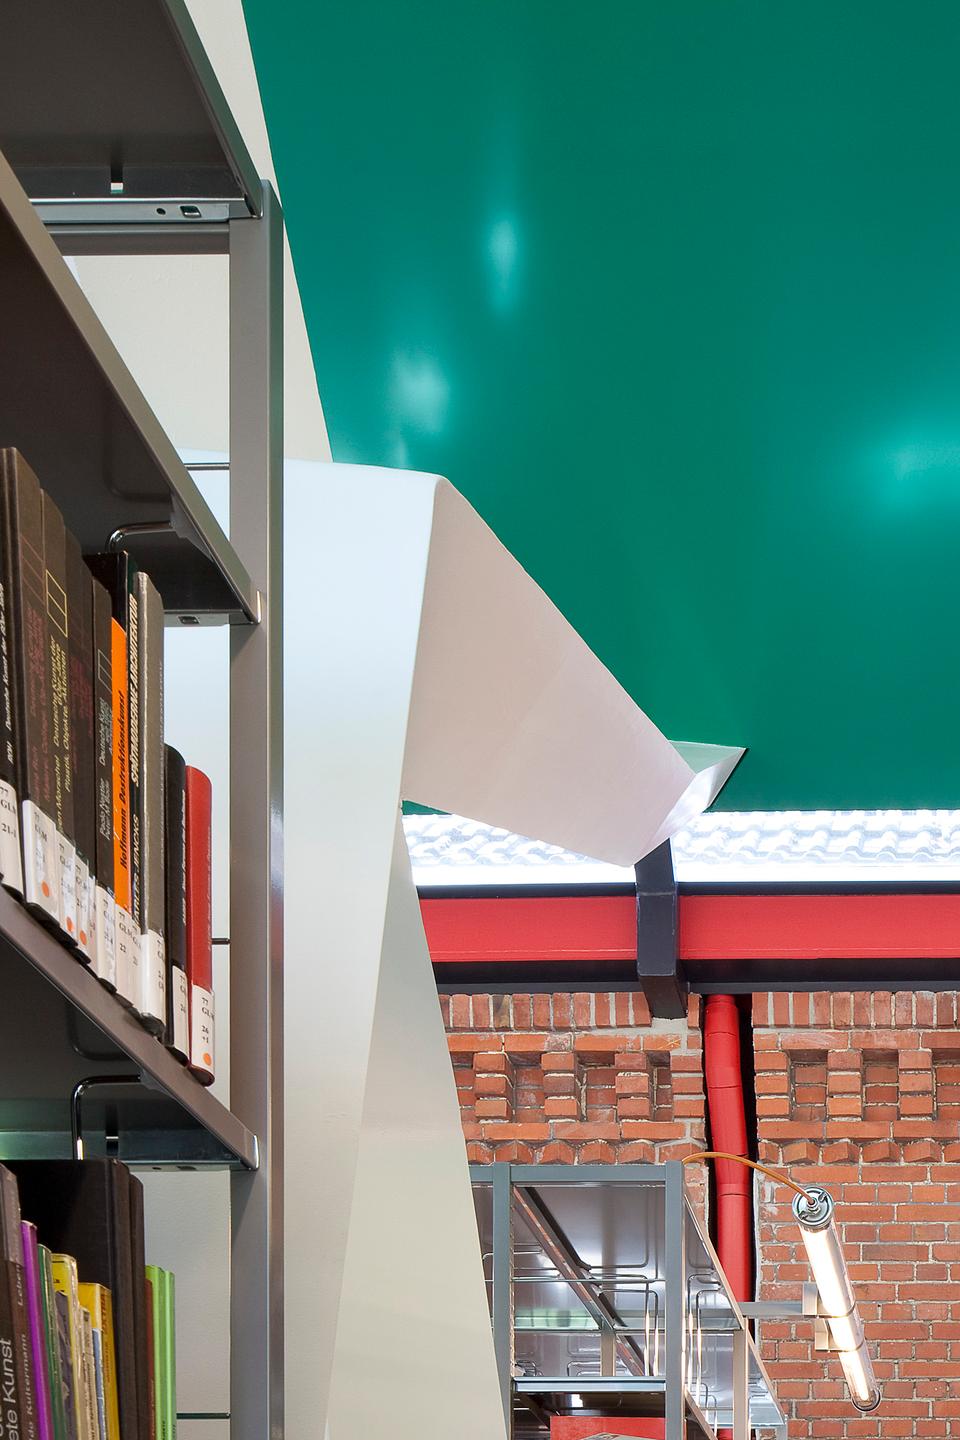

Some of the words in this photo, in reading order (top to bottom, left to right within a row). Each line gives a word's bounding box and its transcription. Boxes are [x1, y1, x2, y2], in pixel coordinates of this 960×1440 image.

[52, 692, 60, 747] Deutsche
[119, 807, 128, 869] Hoffmann
[132, 814, 140, 869] JENCKS
[3, 1337, 17, 1405] Kunst
[22, 1334, 33, 1416] Kultermann
